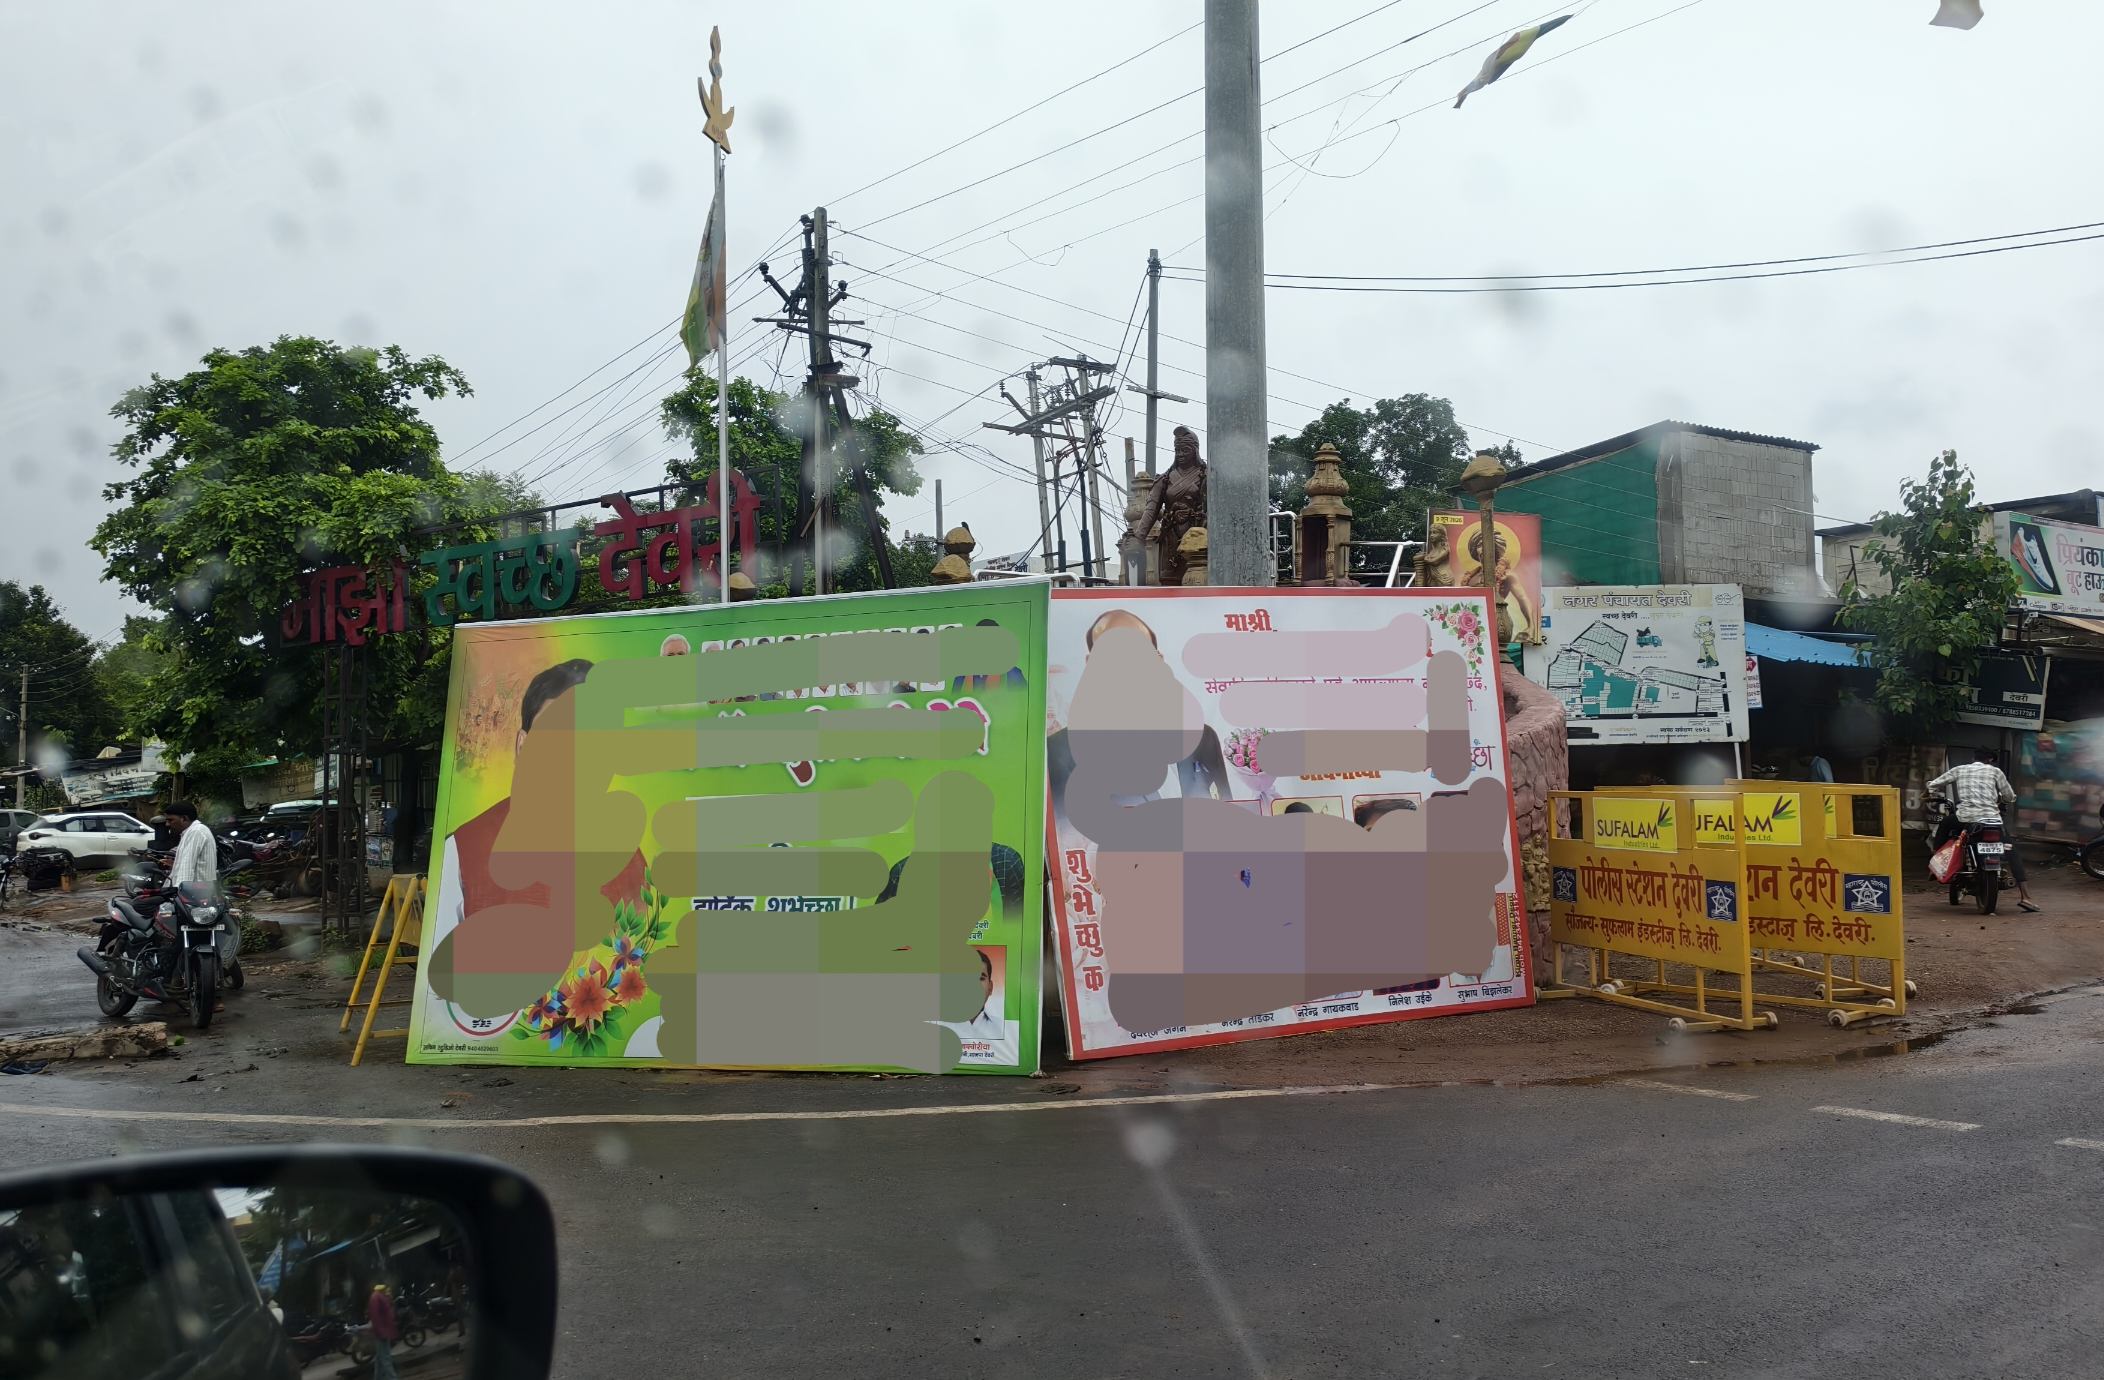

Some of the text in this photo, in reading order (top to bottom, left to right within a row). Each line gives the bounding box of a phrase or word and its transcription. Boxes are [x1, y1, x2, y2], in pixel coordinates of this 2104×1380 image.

[420, 527, 582, 626] स्वच्छ
[595, 468, 760, 600] देवरी
[1563, 589, 1692, 607] नगर पंचायत देवरी
[1621, 611, 1638, 620] देवरी
[1597, 819, 1659, 839] SUFALAM
[1696, 814, 1773, 832] FALAM
[1580, 856, 1704, 918] पोलीस स्टेशन देवरी
[1788, 857, 1839, 909] देवरी
[1600, 917, 1634, 943] सुफलाम
[1297, 1002, 1360, 1017] नरेन्द्र गायकवाड
[1388, 995, 1411, 1007] निलेश
